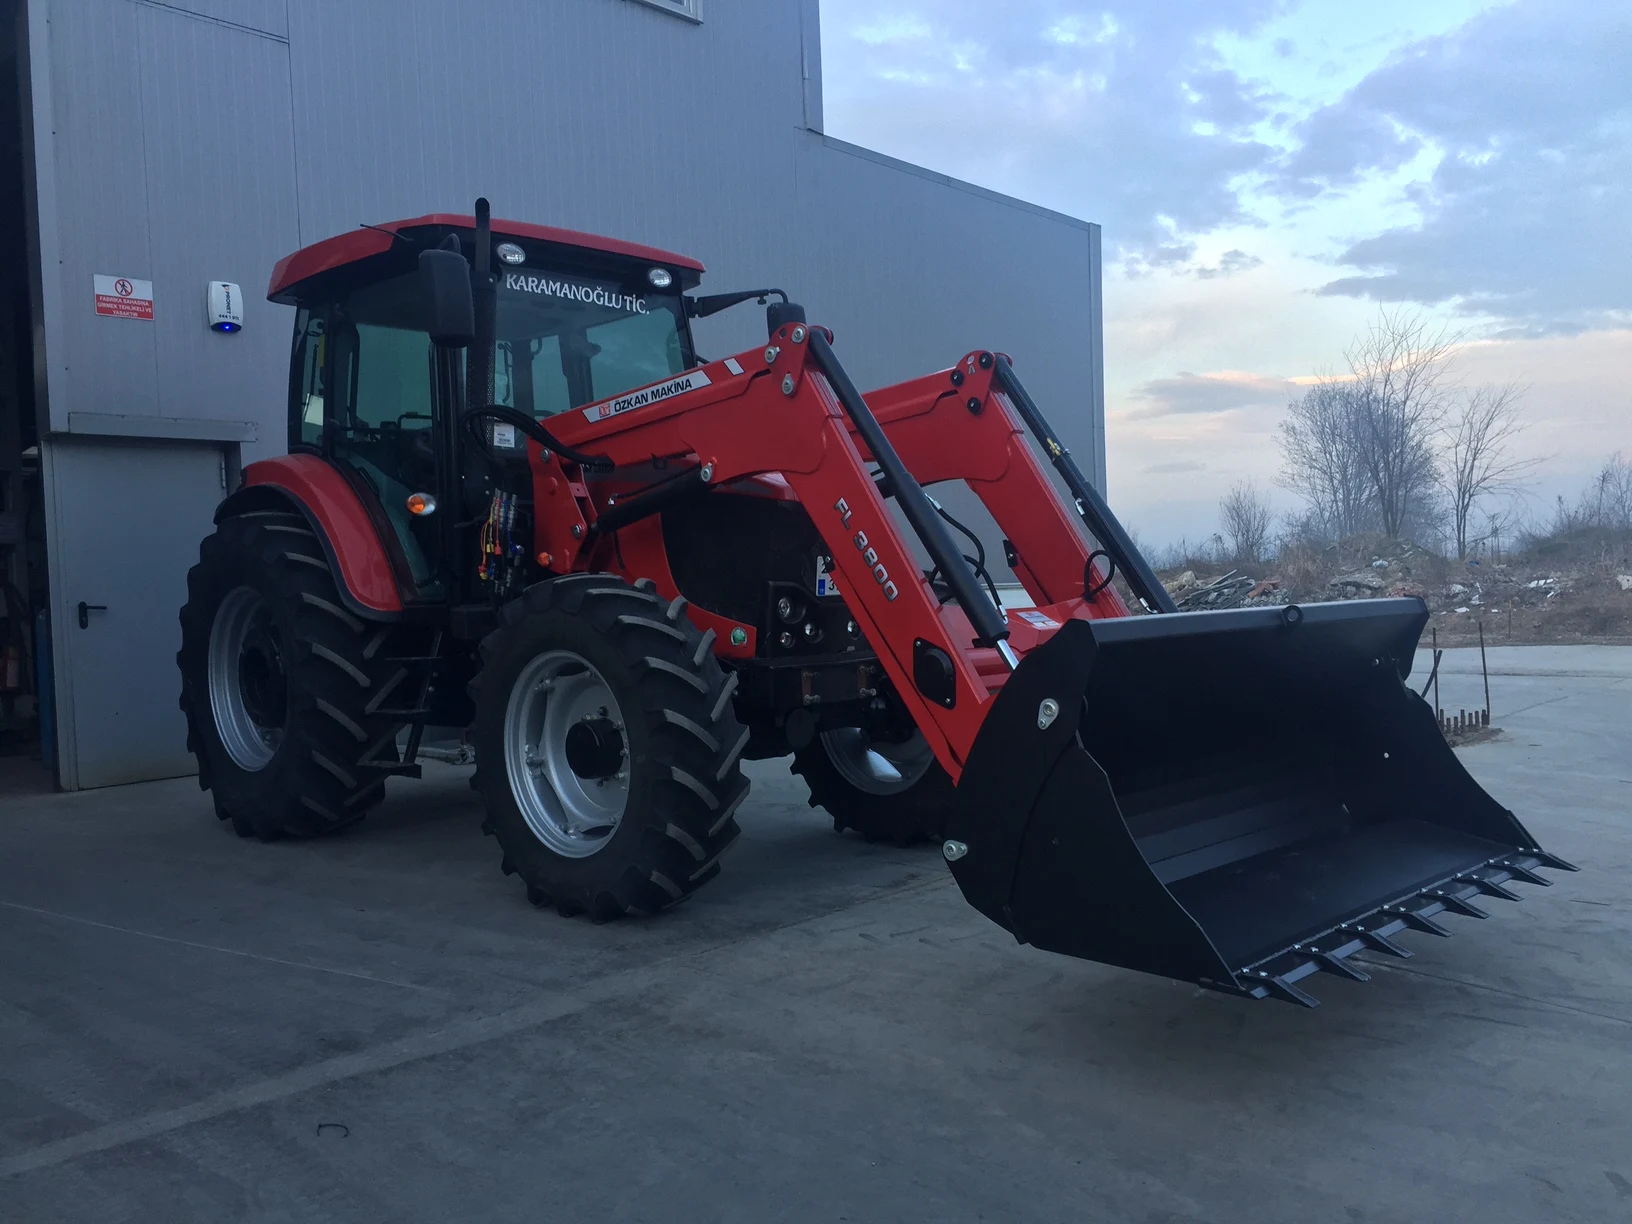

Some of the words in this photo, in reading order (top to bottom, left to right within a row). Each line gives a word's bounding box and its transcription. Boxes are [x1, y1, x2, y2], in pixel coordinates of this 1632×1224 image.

[506, 273, 622, 309] KARAMANOĞLU
[623, 294, 651, 315] TİC.
[614, 392, 649, 413] ÖZKAN
[651, 378, 693, 401] MAKİNA
[833, 497, 852, 531] FL
[853, 530, 899, 602] 3800
